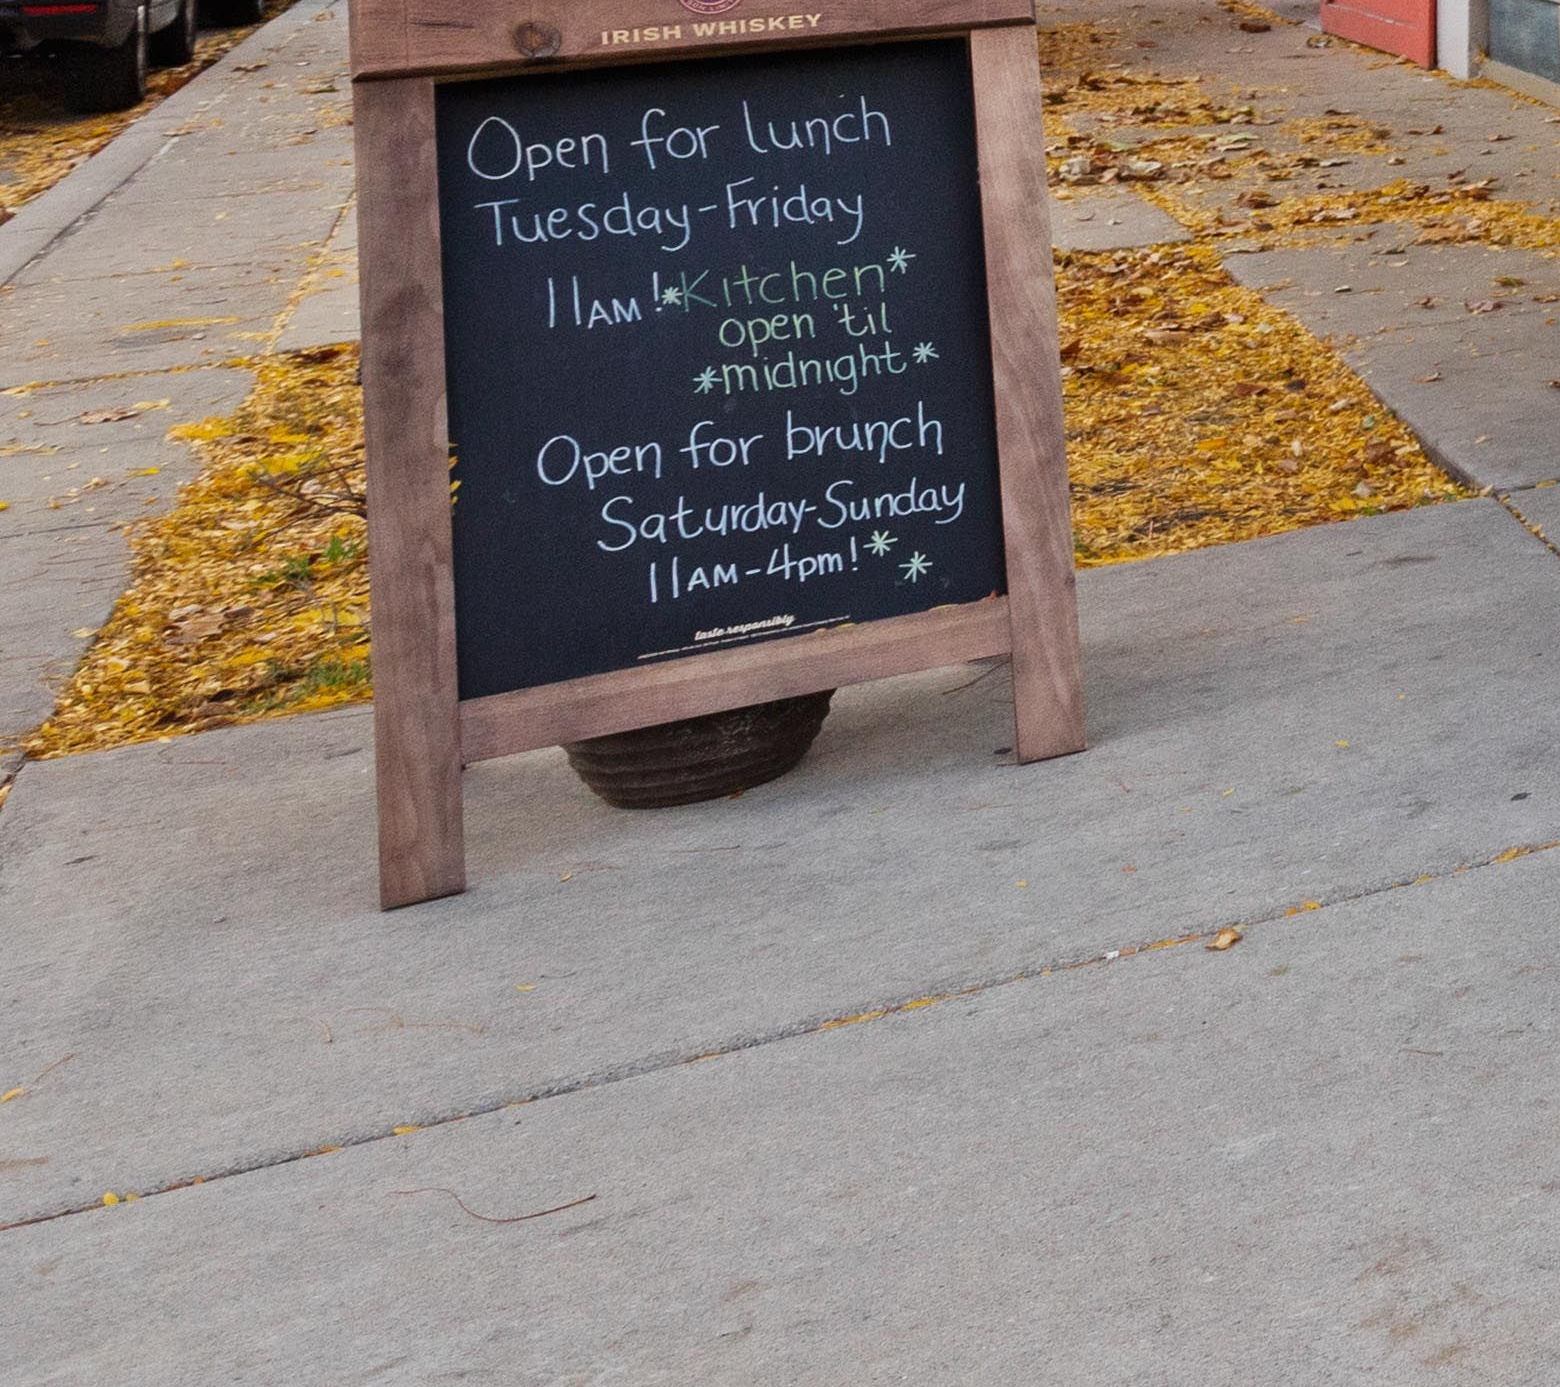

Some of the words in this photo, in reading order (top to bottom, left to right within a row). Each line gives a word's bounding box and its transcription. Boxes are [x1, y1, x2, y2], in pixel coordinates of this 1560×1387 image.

[601, 25, 682, 45] IRISH
[693, 13, 822, 37] WHISKEY
[467, 116, 609, 181] Open
[629, 107, 720, 170] for
[742, 94, 892, 156] lunch
[718, 312, 817, 358] open
[536, 434, 662, 490] Open
[679, 420, 765, 469] for
[786, 400, 944, 464] brunch
